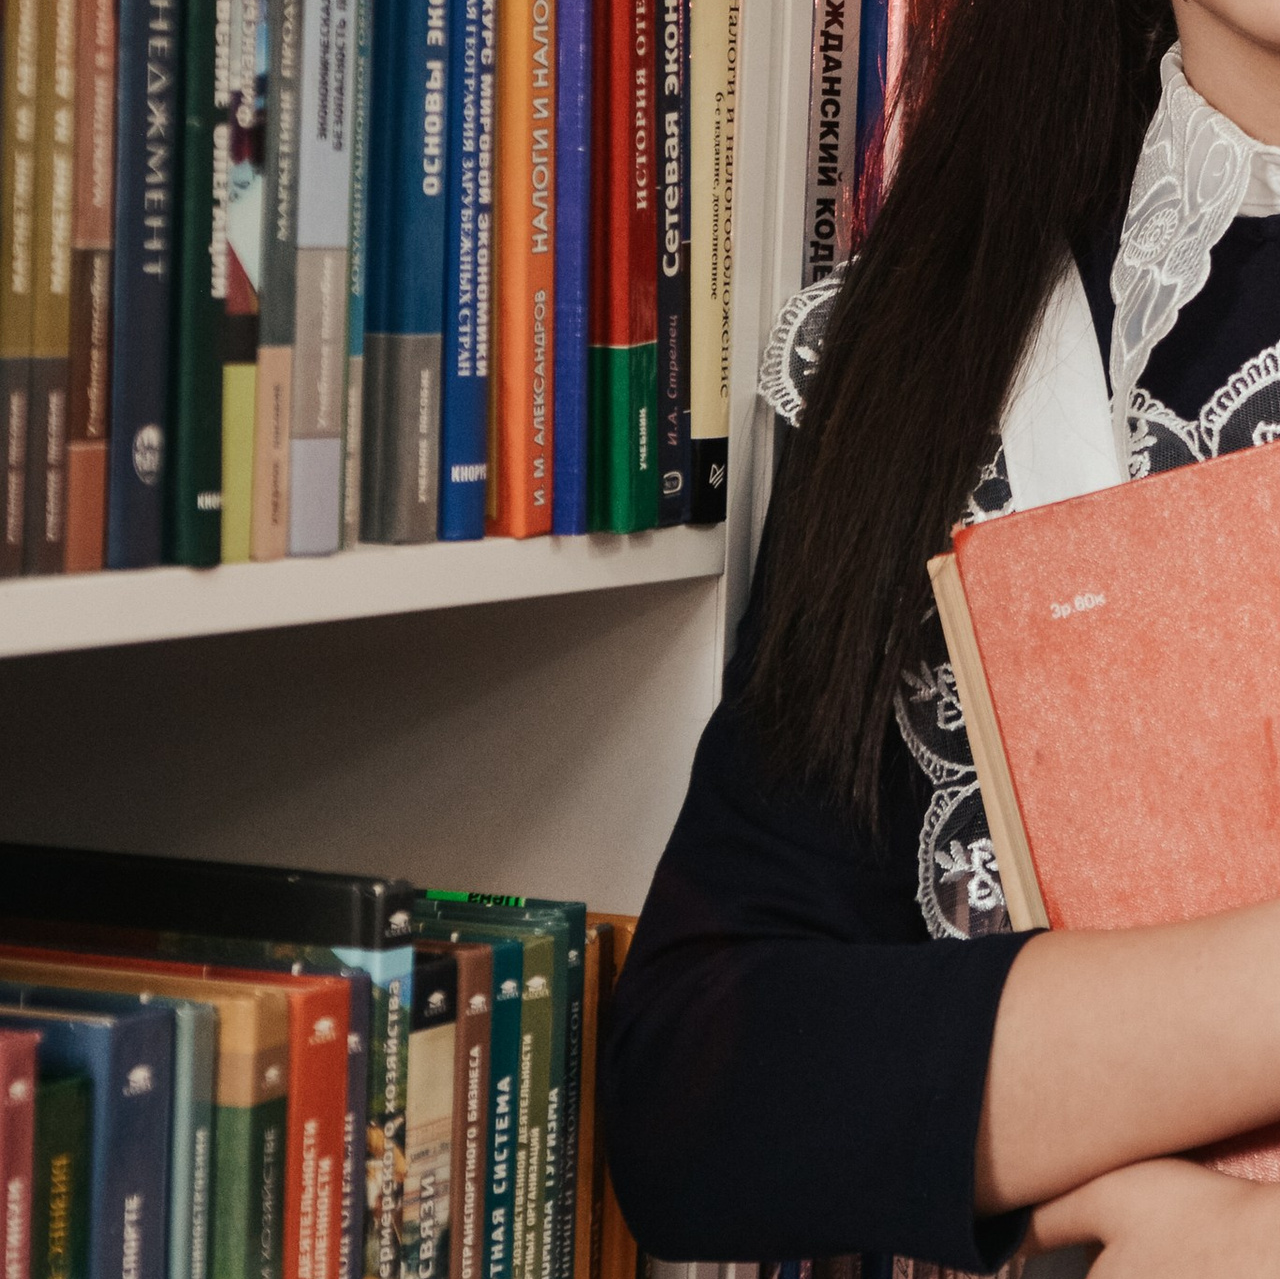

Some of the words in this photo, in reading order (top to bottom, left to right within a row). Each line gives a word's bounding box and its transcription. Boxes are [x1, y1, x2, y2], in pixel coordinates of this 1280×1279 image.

[331, 17, 347, 152] БЕЗОПАСНОСТЬ
[423, 60, 445, 196] ОСНОВЫ
[461, 26, 478, 153] ГЕОГРАФИЯ
[476, 74, 494, 204] МИРОВОЙ
[533, 96, 549, 119] И
[635, 67, 648, 211] ИСТОРИЯ
[713, 91, 725, 116] 6-е
[725, 107, 734, 123] и
[207, 123, 230, 299] ОПЕРАЦИИ
[275, 87, 295, 241] МАРКЕТИНГ
[532, 128, 549, 254] НАЛОГИ
[661, 112, 680, 278] Сетевая
[457, 155, 475, 306] ЗАРУБЕЖНЫХ
[709, 193, 721, 301] дополненное
[720, 134, 735, 399] налогообложение
[456, 308, 472, 378] СТРАН
[474, 213, 490, 378] ЭКОНОМИКИ
[667, 314, 681, 399] Стрелец
[533, 289, 547, 447] АЛЕКСАНДРОВ
[532, 452, 545, 479] М.
[532, 483, 545, 506] И.
[638, 407, 647, 471] УЧЕБНИК
[380, 980, 402, 1114] хозяйства
[465, 1045, 482, 1123] БИЗНЕСА
[516, 1032, 534, 1144] ДЕЯТЕЛЬНОСТИ
[563, 1001, 581, 1181] ТУРКОМПЛЕКСОВ
[259, 1126, 276, 1262] ХОЗЯЙСТВЕ
[492, 1074, 512, 1195] СИСТЕМА
[523, 1126, 541, 1227] ОРГАНИЗАЦИЙ
[564, 1190, 574, 1206] И
